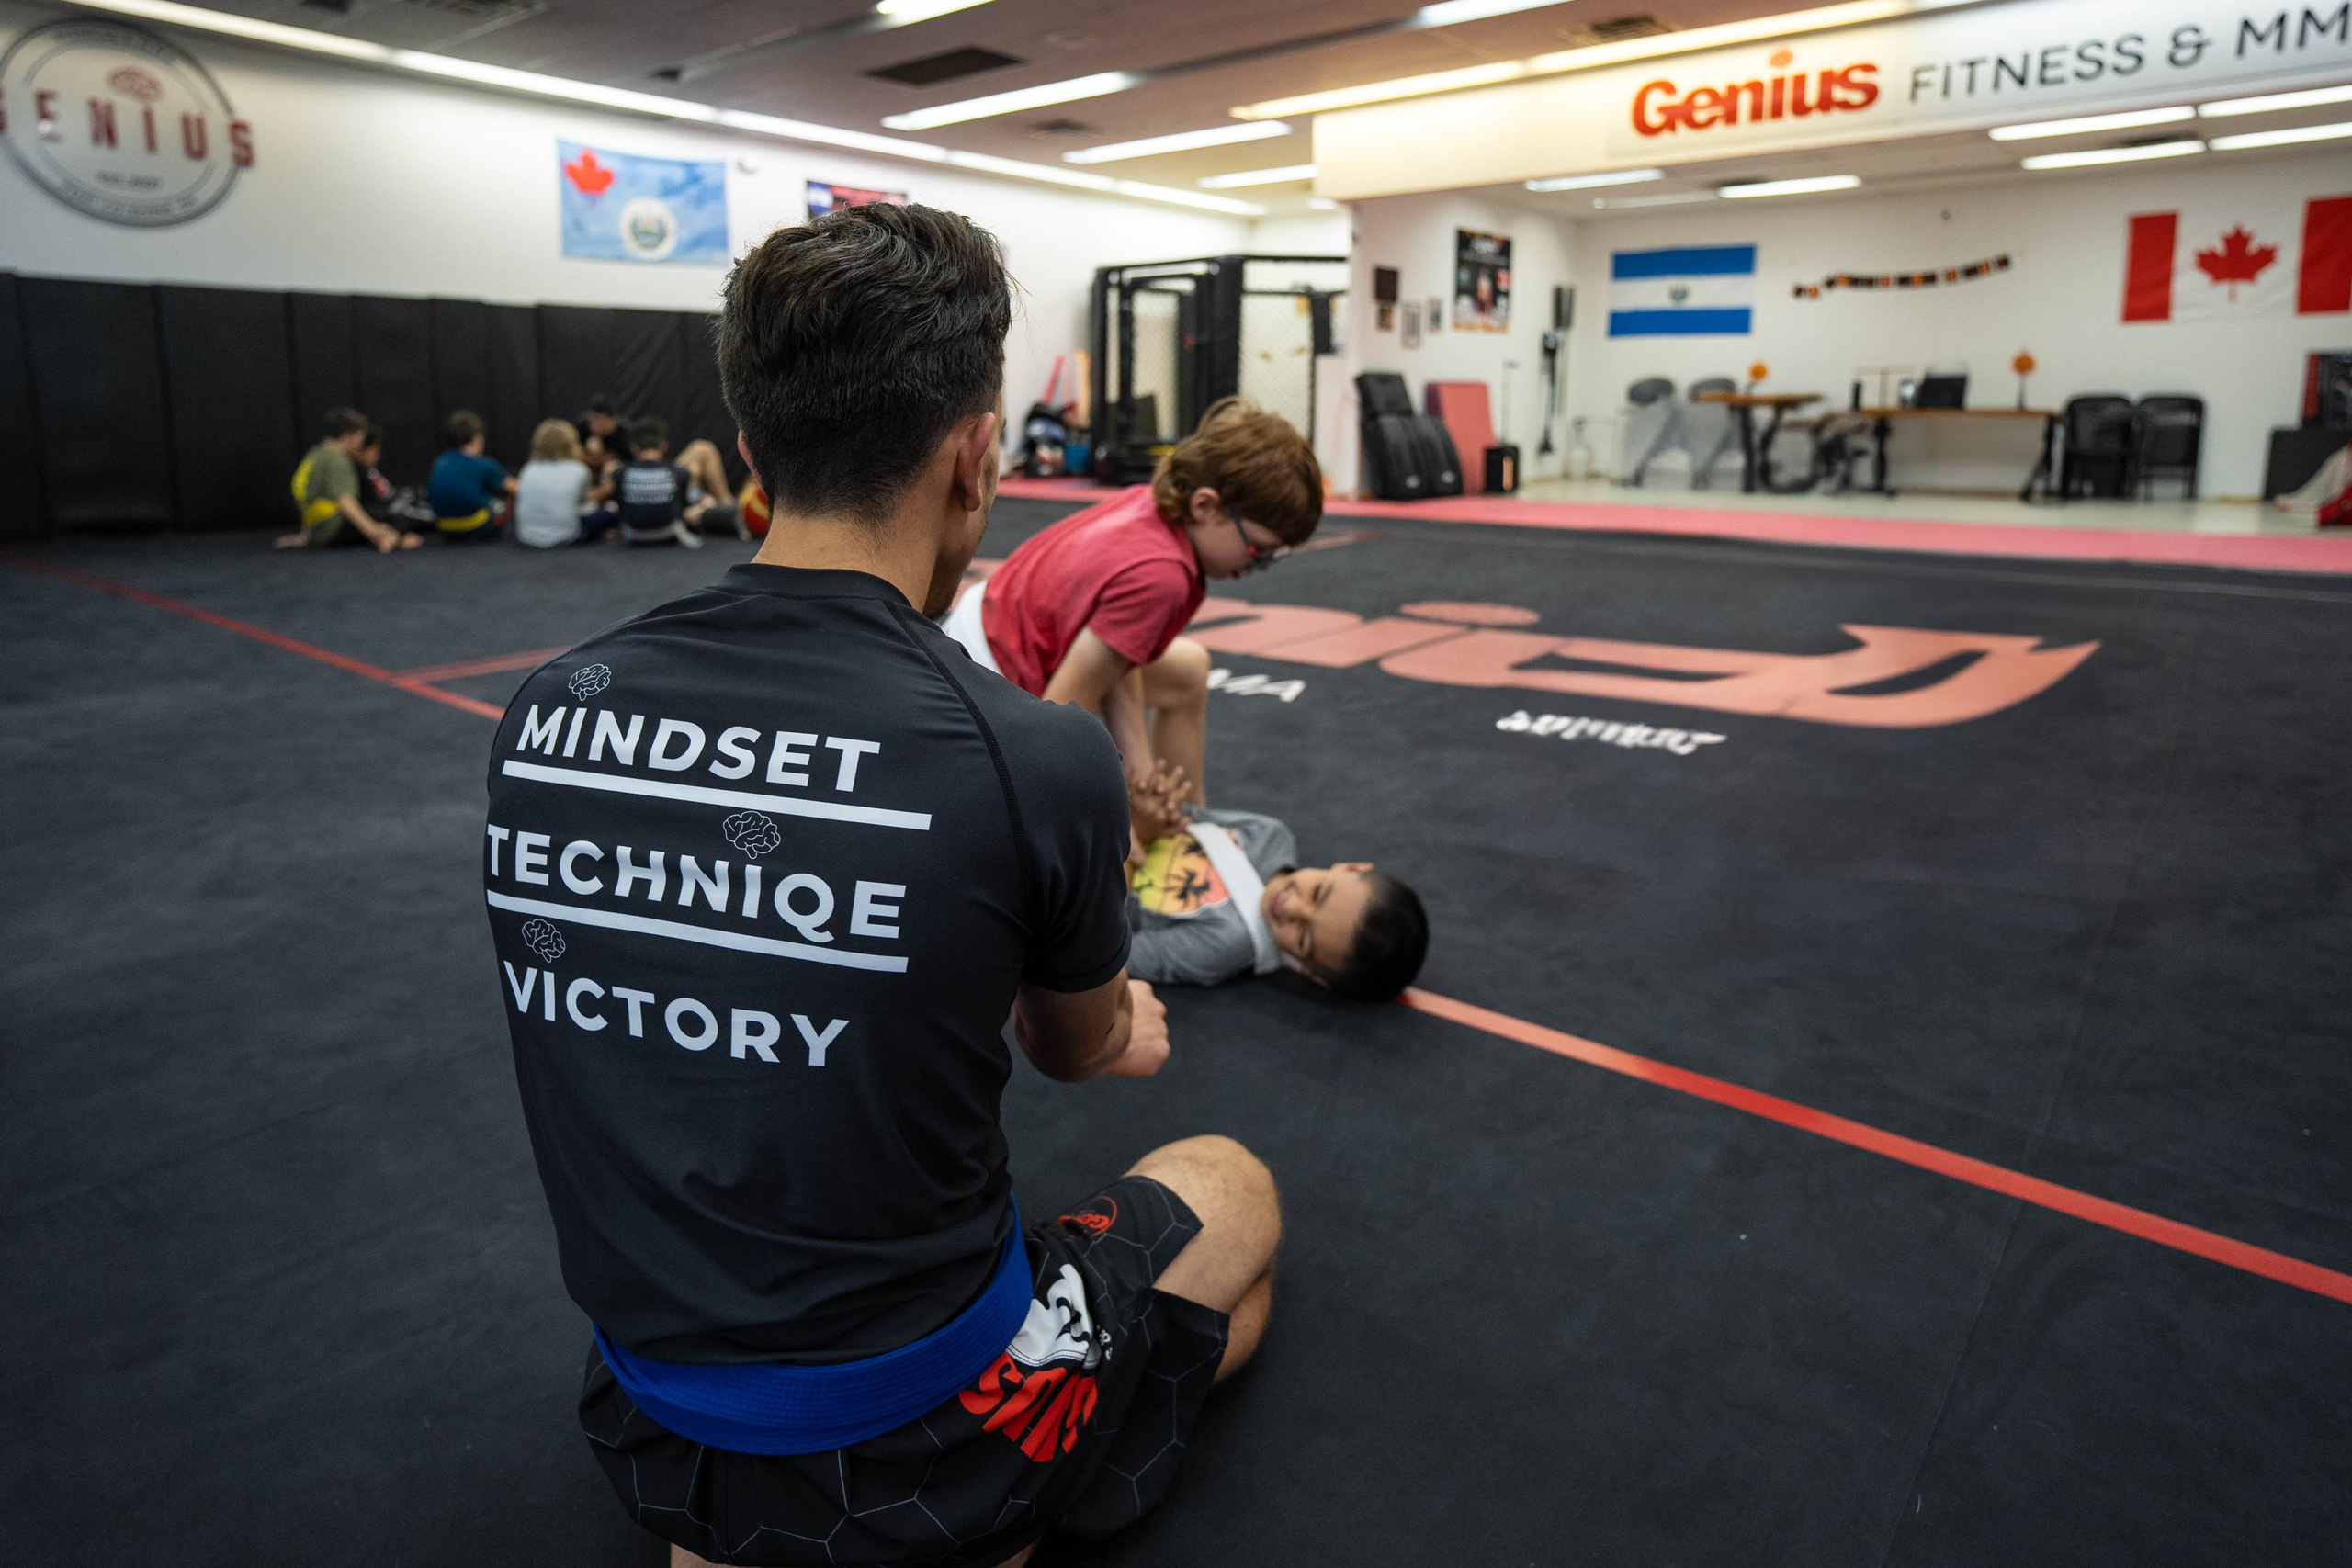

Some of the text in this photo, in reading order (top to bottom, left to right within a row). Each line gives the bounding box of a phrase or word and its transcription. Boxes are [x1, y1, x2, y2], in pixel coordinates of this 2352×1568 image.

[0, 87, 254, 167] ENIUS
[1631, 49, 1879, 137] Genius
[1908, 34, 2144, 103] FITNESS
[2166, 25, 2211, 69] &
[516, 704, 881, 793] MINDSET
[487, 823, 907, 943] TECHNIQE
[503, 960, 850, 1066] VICTORY
